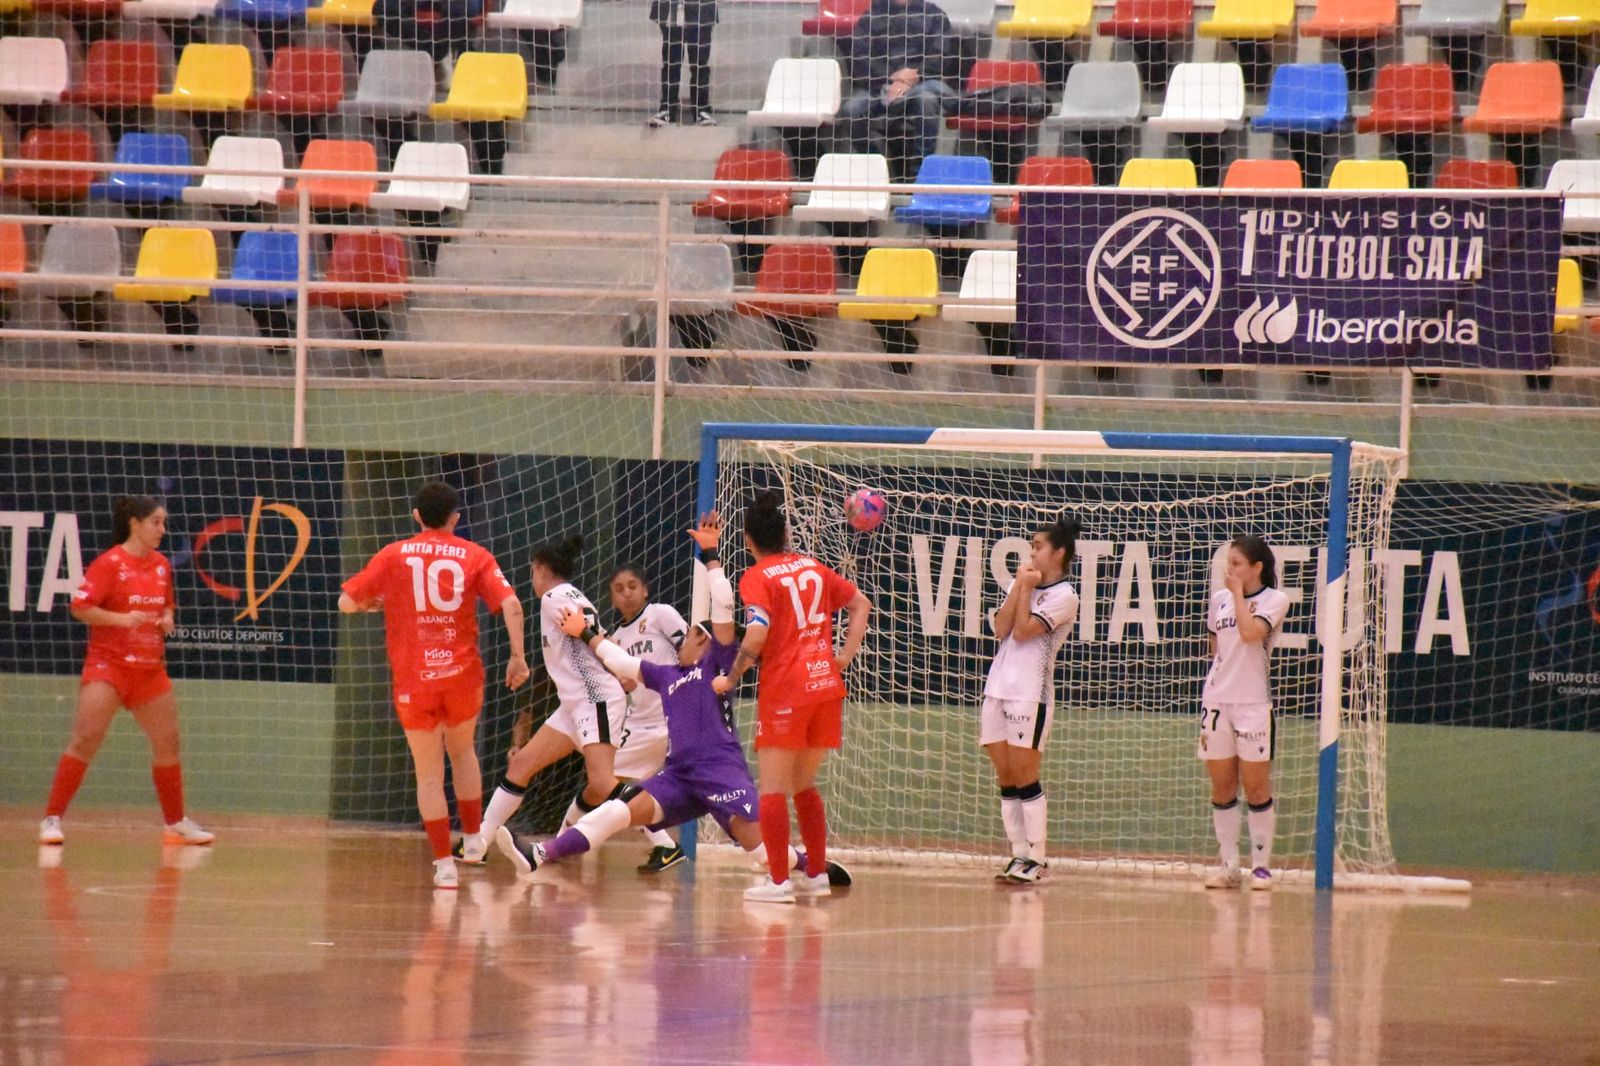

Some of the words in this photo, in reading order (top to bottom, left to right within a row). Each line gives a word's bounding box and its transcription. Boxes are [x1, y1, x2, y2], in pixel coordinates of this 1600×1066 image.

[1283, 206, 1487, 230] DIVISIÓN
[1277, 225, 1394, 281] FÚTBOL
[1406, 235, 1483, 281] SALA
[1306, 308, 1479, 345] Iberdrola
[401, 543, 433, 554] ANTÍA
[435, 543, 467, 559] PÉREZ
[405, 556, 465, 613] 10
[911, 534, 1160, 644] VISTA
[780, 570, 827, 630] 12
[220, 630, 234, 641] DE
[236, 631, 285, 642] DEPORTES
[1528, 671, 1584, 684] INSTITUTO
[1201, 706, 1221, 732] 27
[717, 788, 747, 803] HELITY
